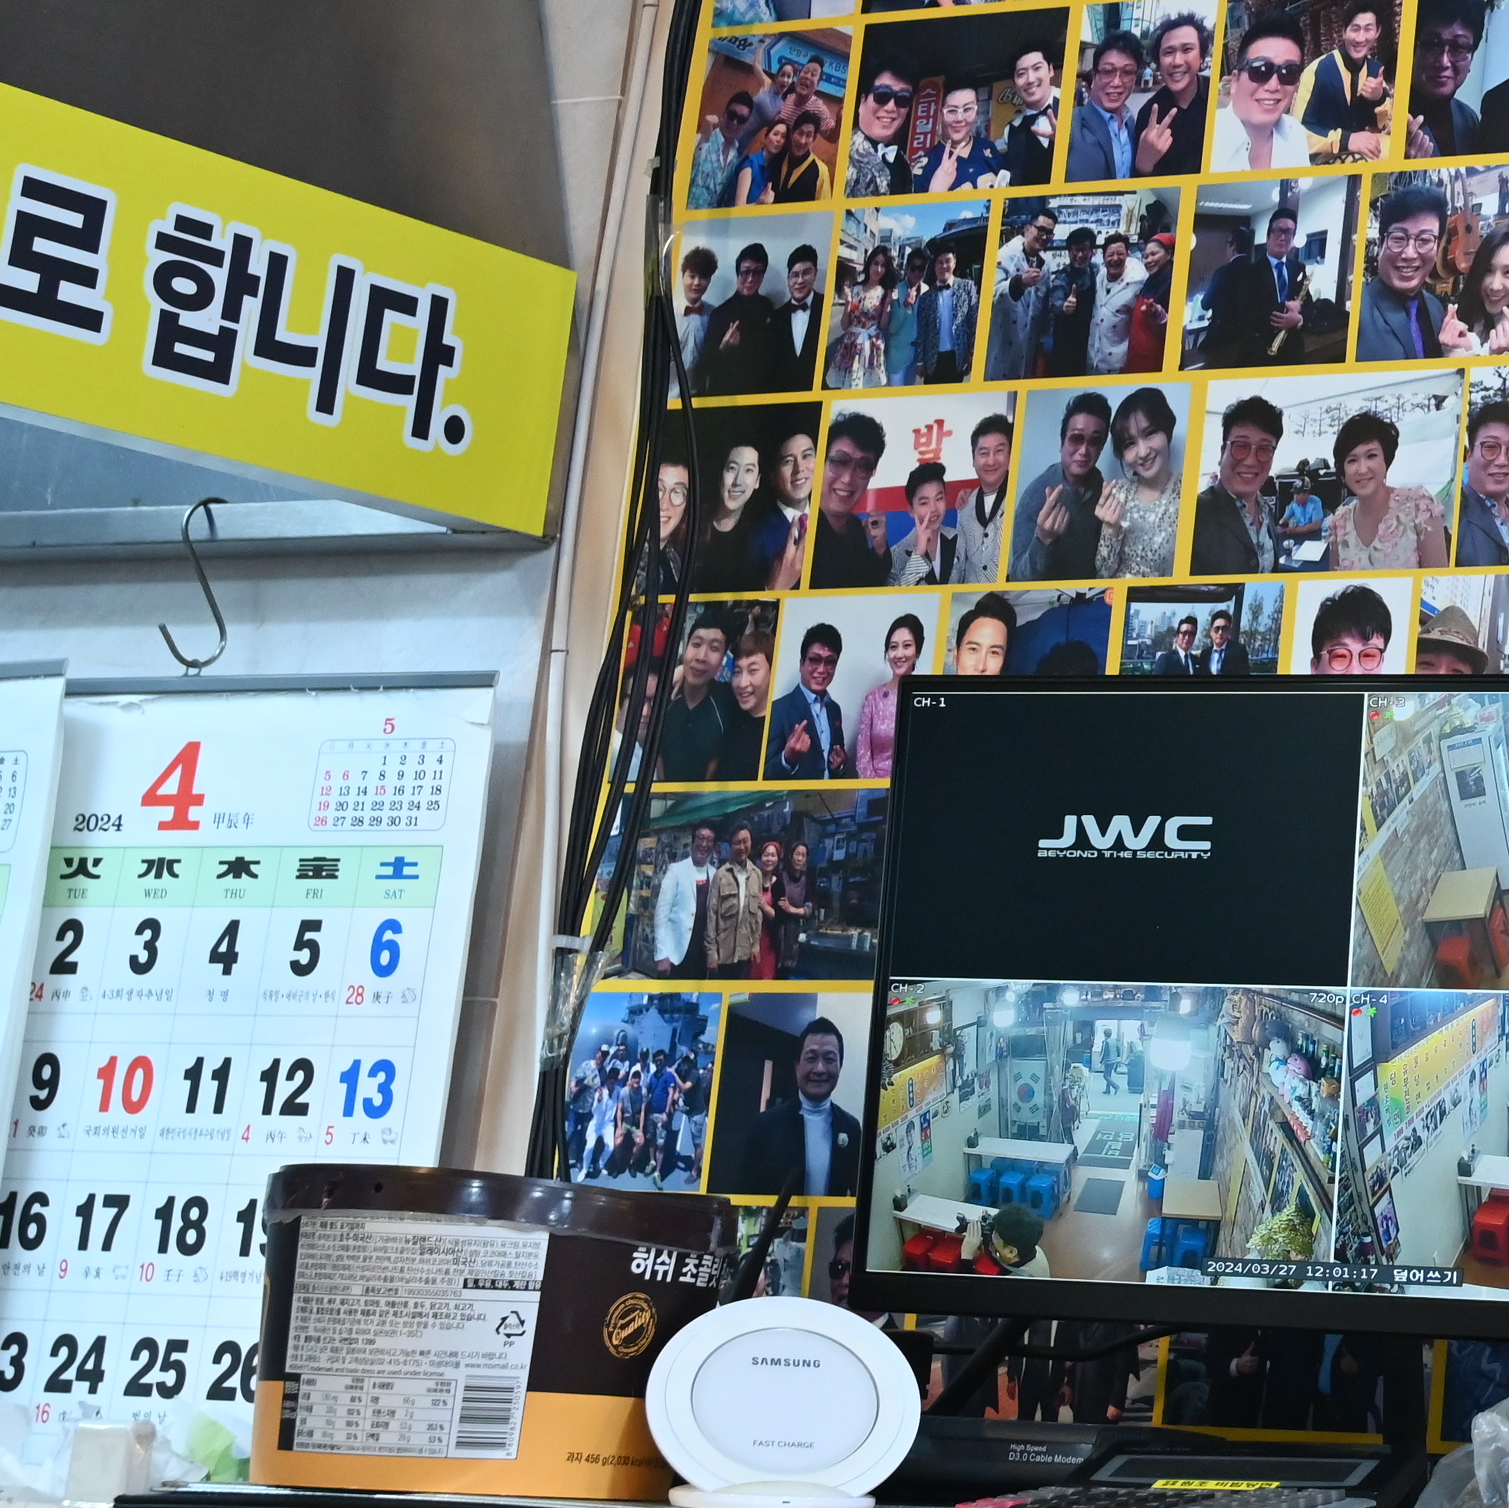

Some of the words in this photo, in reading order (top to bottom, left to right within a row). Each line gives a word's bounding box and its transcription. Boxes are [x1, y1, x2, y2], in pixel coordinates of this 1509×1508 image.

[151, 213, 467, 446] 합니다.
[913, 697, 946, 707] CH-1
[383, 718, 395, 734] 5
[73, 813, 123, 832] 2024
[141, 741, 205, 831] 4
[1037, 814, 1213, 850] JWC
[1037, 849, 1098, 858] BEYOND
[1102, 850, 1133, 859] THE
[1136, 850, 1212, 859] SECURITY
[59, 857, 103, 880] 火
[137, 857, 182, 880] 水
[216, 856, 261, 879] 木
[295, 857, 341, 880] 金
[375, 856, 419, 880] 土
[67, 887, 85, 899] TUE
[144, 888, 167, 899] WED
[224, 888, 246, 899] THU
[305, 888, 323, 899] FRI
[384, 889, 404, 899] SAT
[49, 918, 84, 975] 2
[129, 918, 161, 975] 3
[208, 919, 240, 976] 4
[289, 919, 323, 977] 5
[370, 918, 403, 978] 6
[890, 983, 925, 994] CH-2
[1309, 992, 1345, 1007] 720p
[1352, 993, 1388, 1005] CH-4
[29, 1052, 60, 1111] 9
[97, 1056, 154, 1114] 10
[183, 1056, 232, 1114] 11
[259, 1057, 314, 1116] 12
[339, 1059, 396, 1119] 13
[75, 1193, 131, 1252] 17
[154, 1195, 209, 1256] 18
[1207, 1260, 1298, 1277] 2024/03/27
[1306, 1266, 1379, 1281] 12:01:17
[1393, 1269, 1459, 1287] 덮어쓰기
[43, 1333, 107, 1395] 24
[123, 1337, 189, 1400] 25
[751, 1356, 821, 1369] SAMSUNG
[752, 1439, 776, 1449] FAST
[777, 1439, 815, 1450] CHARGE
[1008, 1452, 1028, 1463] D3.0
[1030, 1453, 1053, 1464] Cable
[1054, 1454, 1084, 1464] Modem
